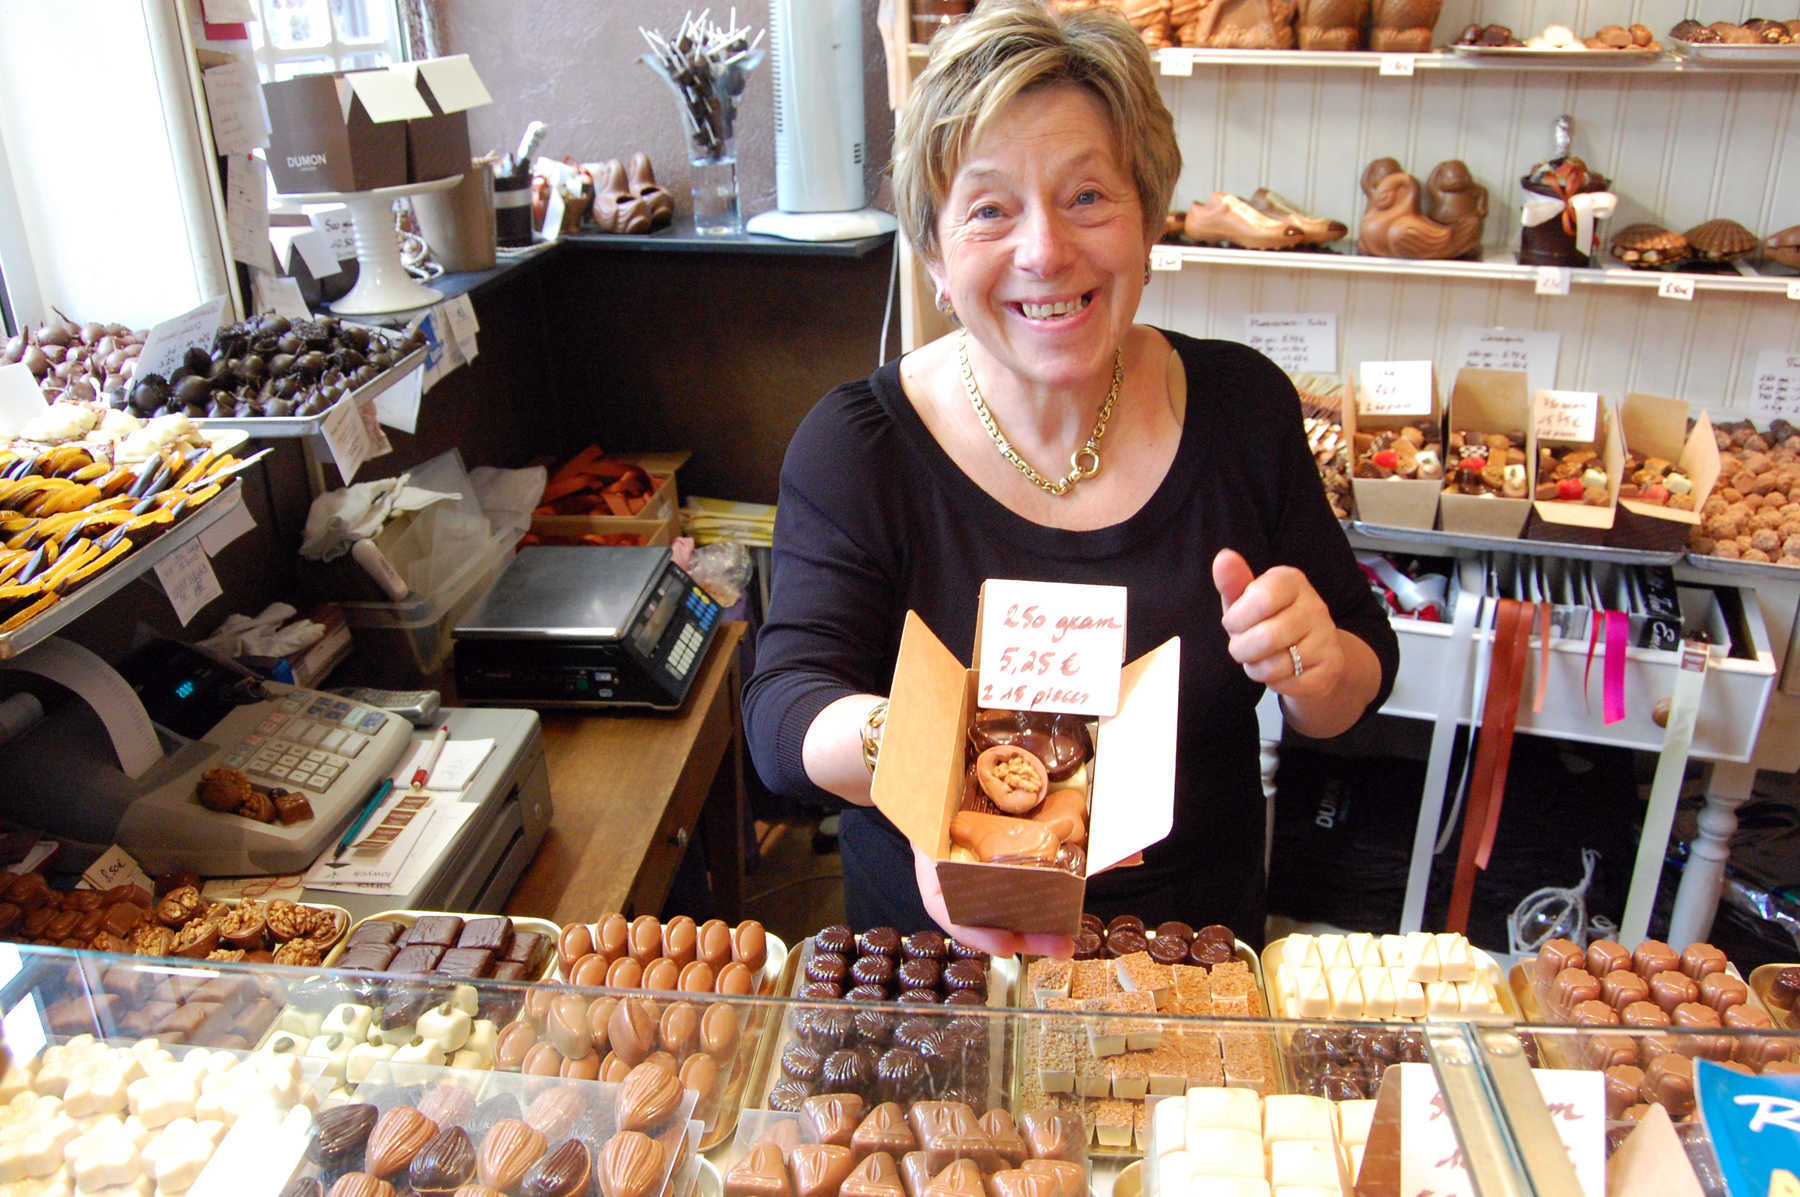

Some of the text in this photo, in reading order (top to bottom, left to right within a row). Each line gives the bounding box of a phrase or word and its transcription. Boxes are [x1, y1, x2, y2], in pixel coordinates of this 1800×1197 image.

[287, 153, 328, 168] DUMON
[1003, 604, 1122, 643] 250 gram
[1000, 646, 1081, 676] 5,25 €
